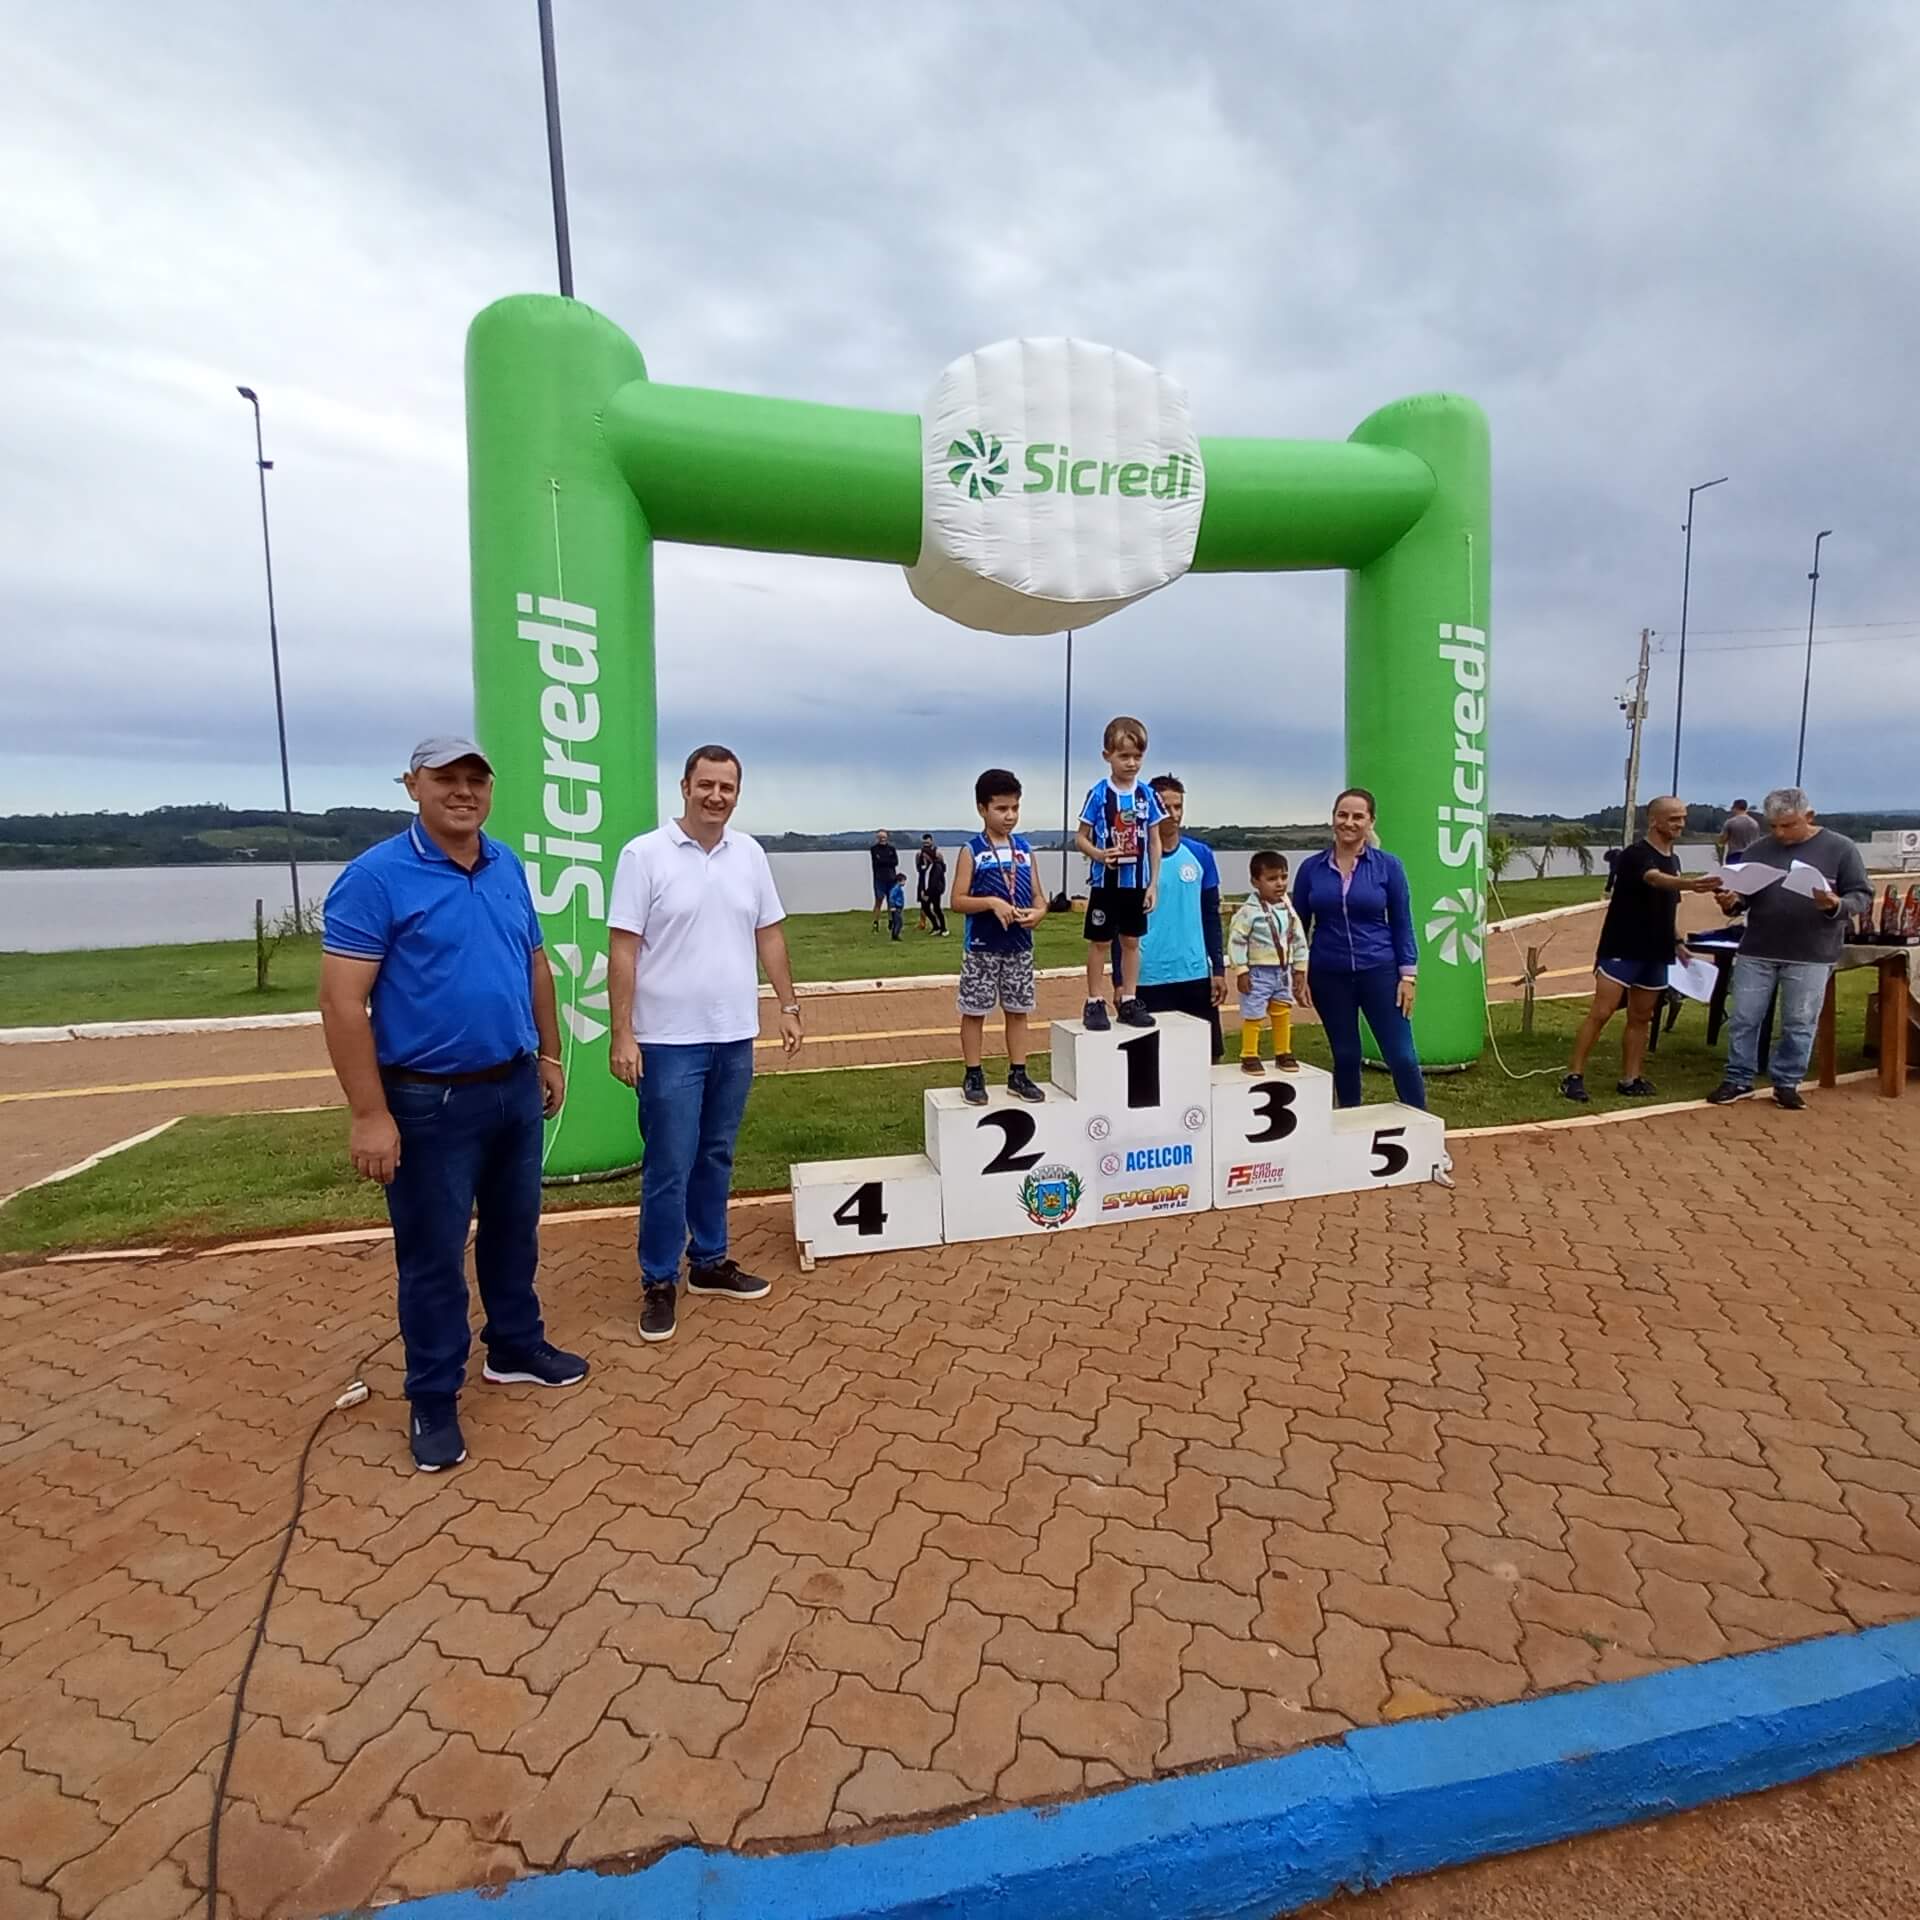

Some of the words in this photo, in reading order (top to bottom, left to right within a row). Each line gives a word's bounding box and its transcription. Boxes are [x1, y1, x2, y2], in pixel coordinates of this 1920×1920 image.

[1023, 443, 1192, 500] Sicredi
[516, 592, 605, 919] Sicredi
[1438, 623, 1486, 869] Sicredi
[1118, 1030, 1161, 1108] 1
[1245, 1081, 1297, 1143] 3
[977, 1109, 1044, 1175] 2
[1126, 1144, 1193, 1172] ACELCOR
[1370, 1127, 1409, 1177] 5
[834, 1182, 887, 1236] 4
[1102, 1184, 1190, 1211] SYGMA
